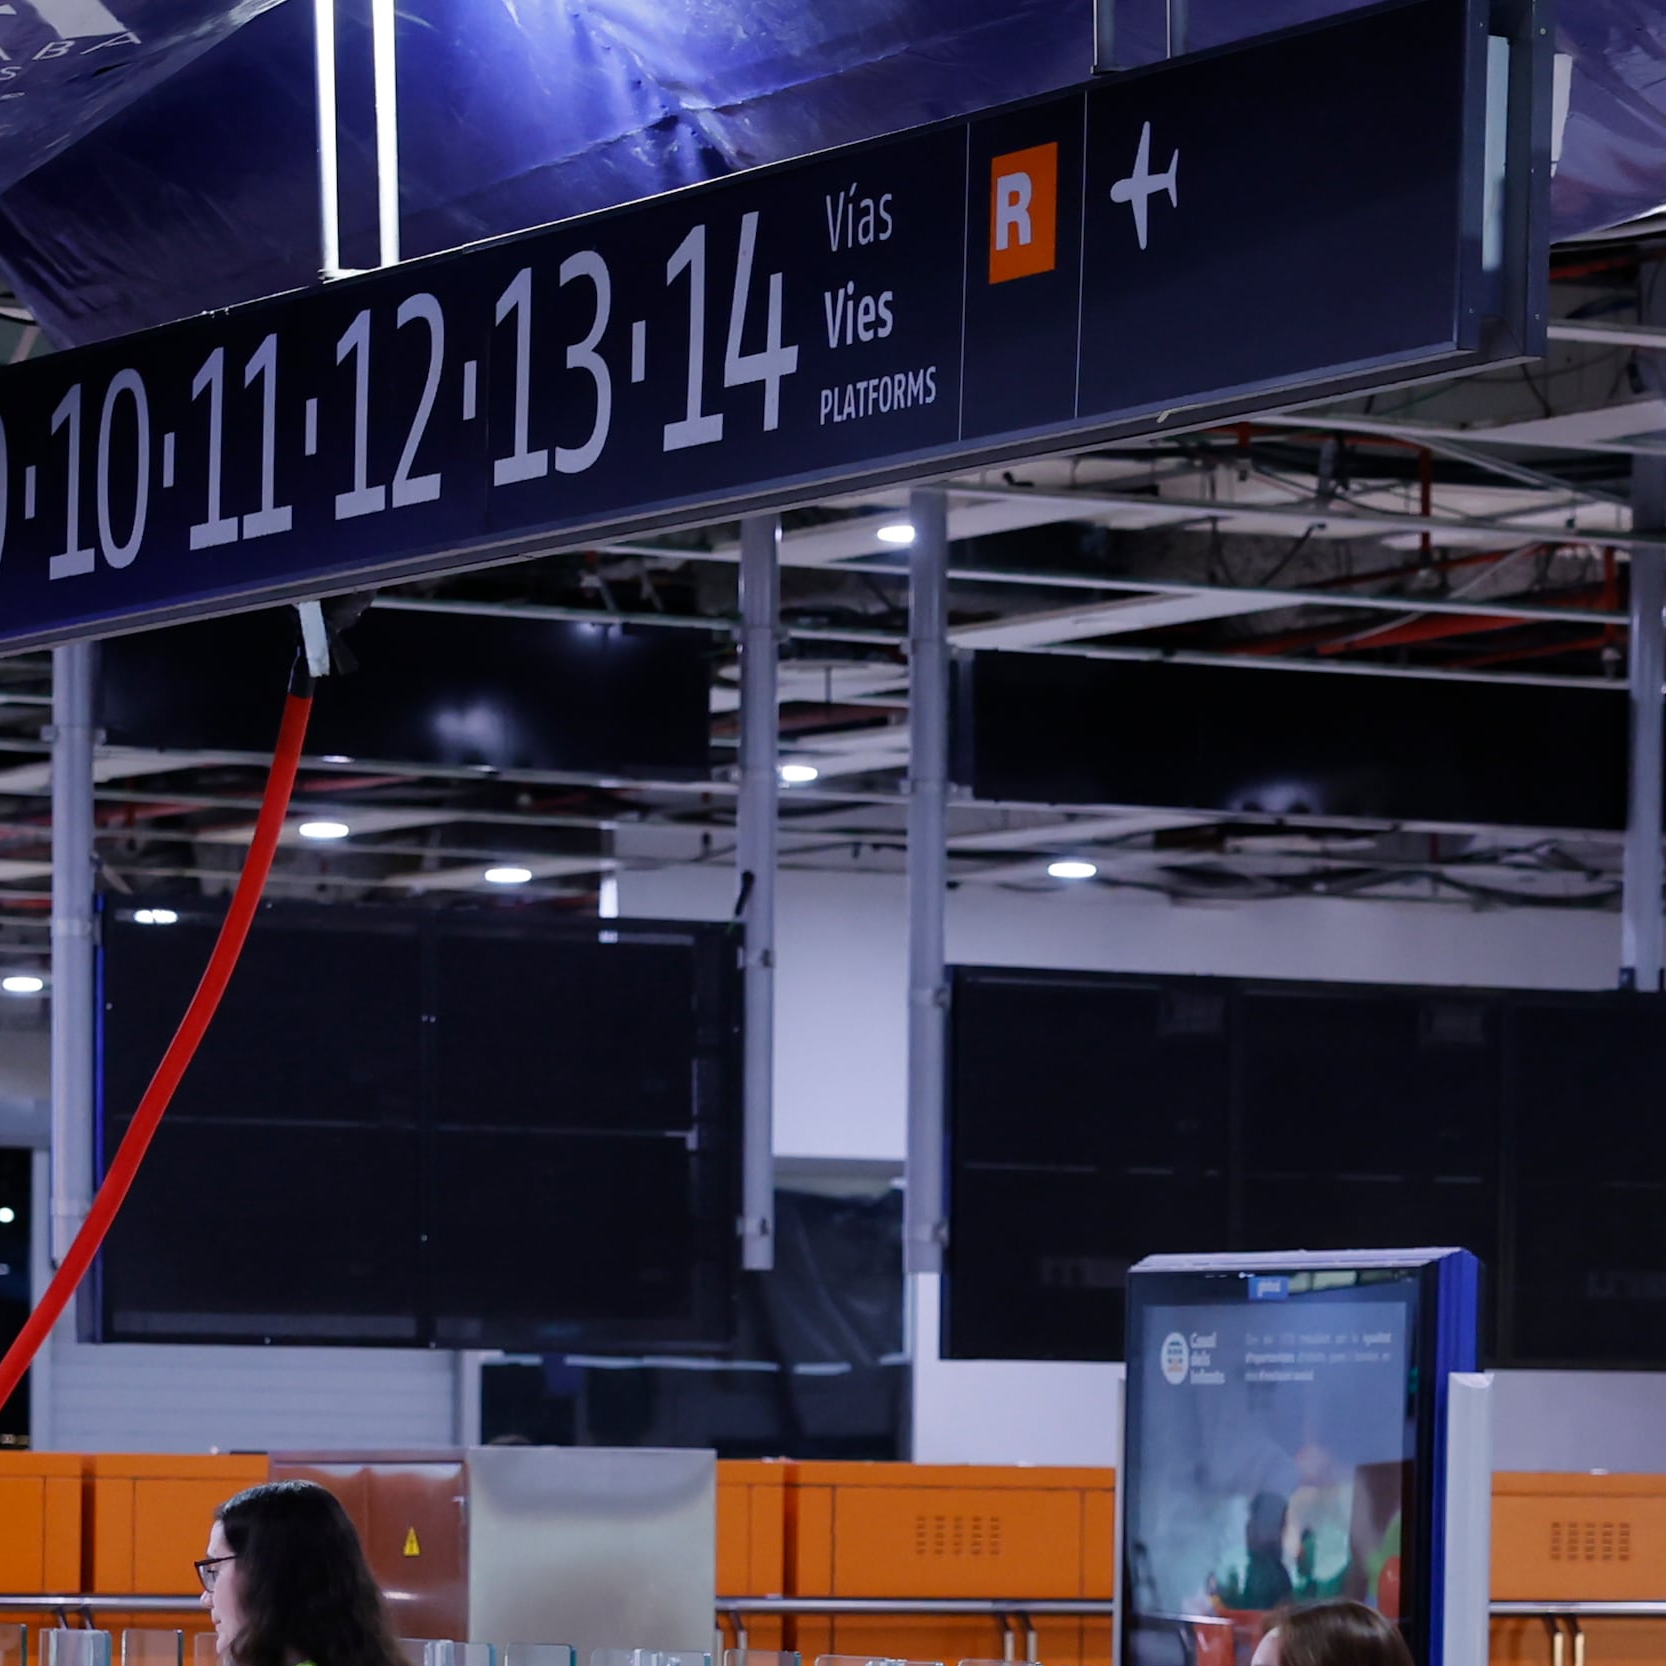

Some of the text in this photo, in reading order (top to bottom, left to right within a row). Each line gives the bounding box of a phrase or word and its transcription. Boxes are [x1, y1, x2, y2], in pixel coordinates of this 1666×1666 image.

[825, 183, 893, 253] Vías
[994, 170, 1032, 251] R
[824, 281, 893, 348] Vies
[820, 365, 937, 425] PLATFORMS
